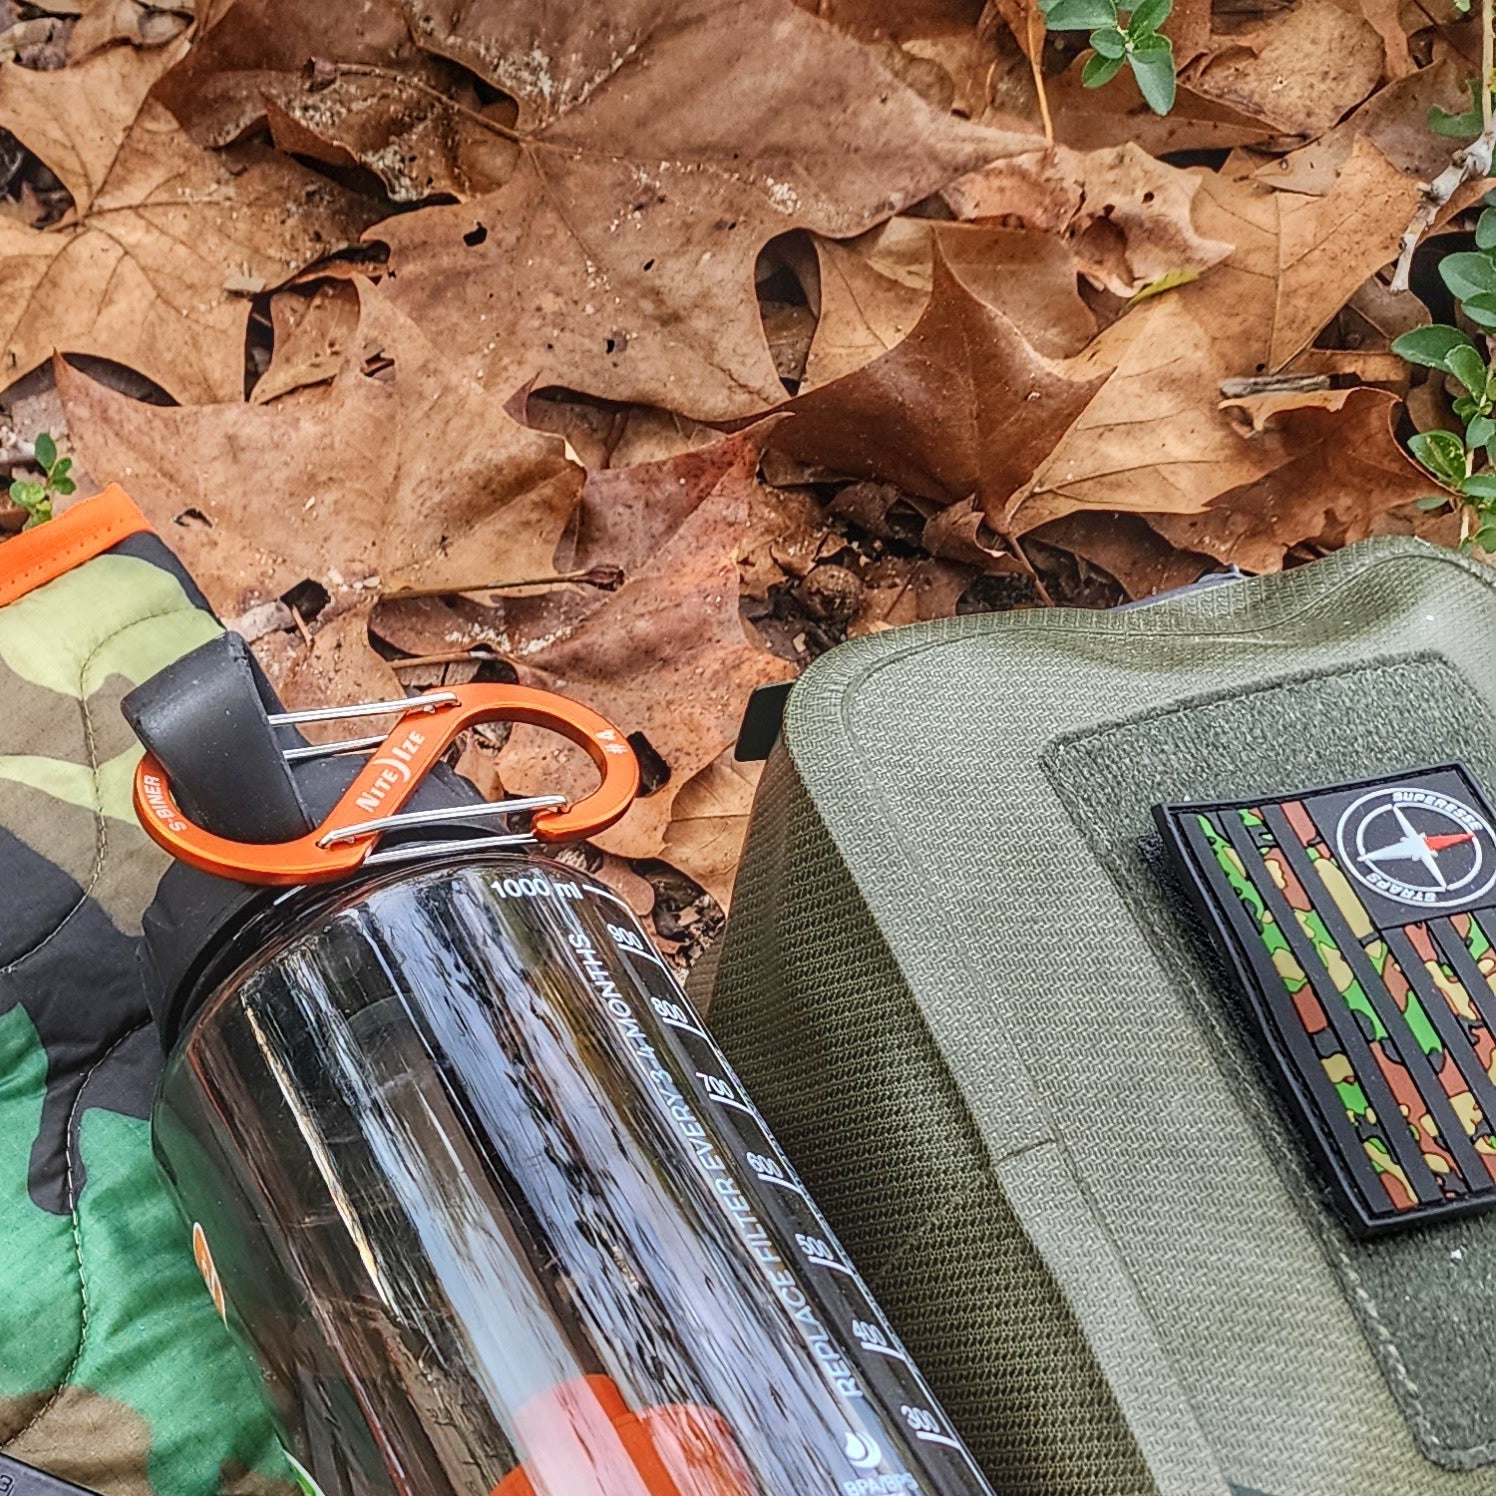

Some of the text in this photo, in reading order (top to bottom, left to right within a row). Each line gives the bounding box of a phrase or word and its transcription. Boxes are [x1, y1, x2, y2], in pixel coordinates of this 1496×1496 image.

[143, 774, 188, 833] S-BINER
[1392, 790, 1484, 831] SUPERESSE
[490, 878, 585, 900] 1000 ml
[1365, 872, 1437, 902] STRAPS
[606, 923, 644, 951] 900
[565, 926, 646, 1045] MONTHS
[650, 996, 689, 1024] 800
[695, 1071, 735, 1100] 700
[658, 1082, 726, 1176] EVERY
[746, 1151, 784, 1179] 600
[712, 1171, 782, 1268] FILTER
[794, 1232, 835, 1261] 500
[765, 1261, 865, 1404] REPLACE
[851, 1319, 888, 1347] 400
[900, 1404, 941, 1434] 300
